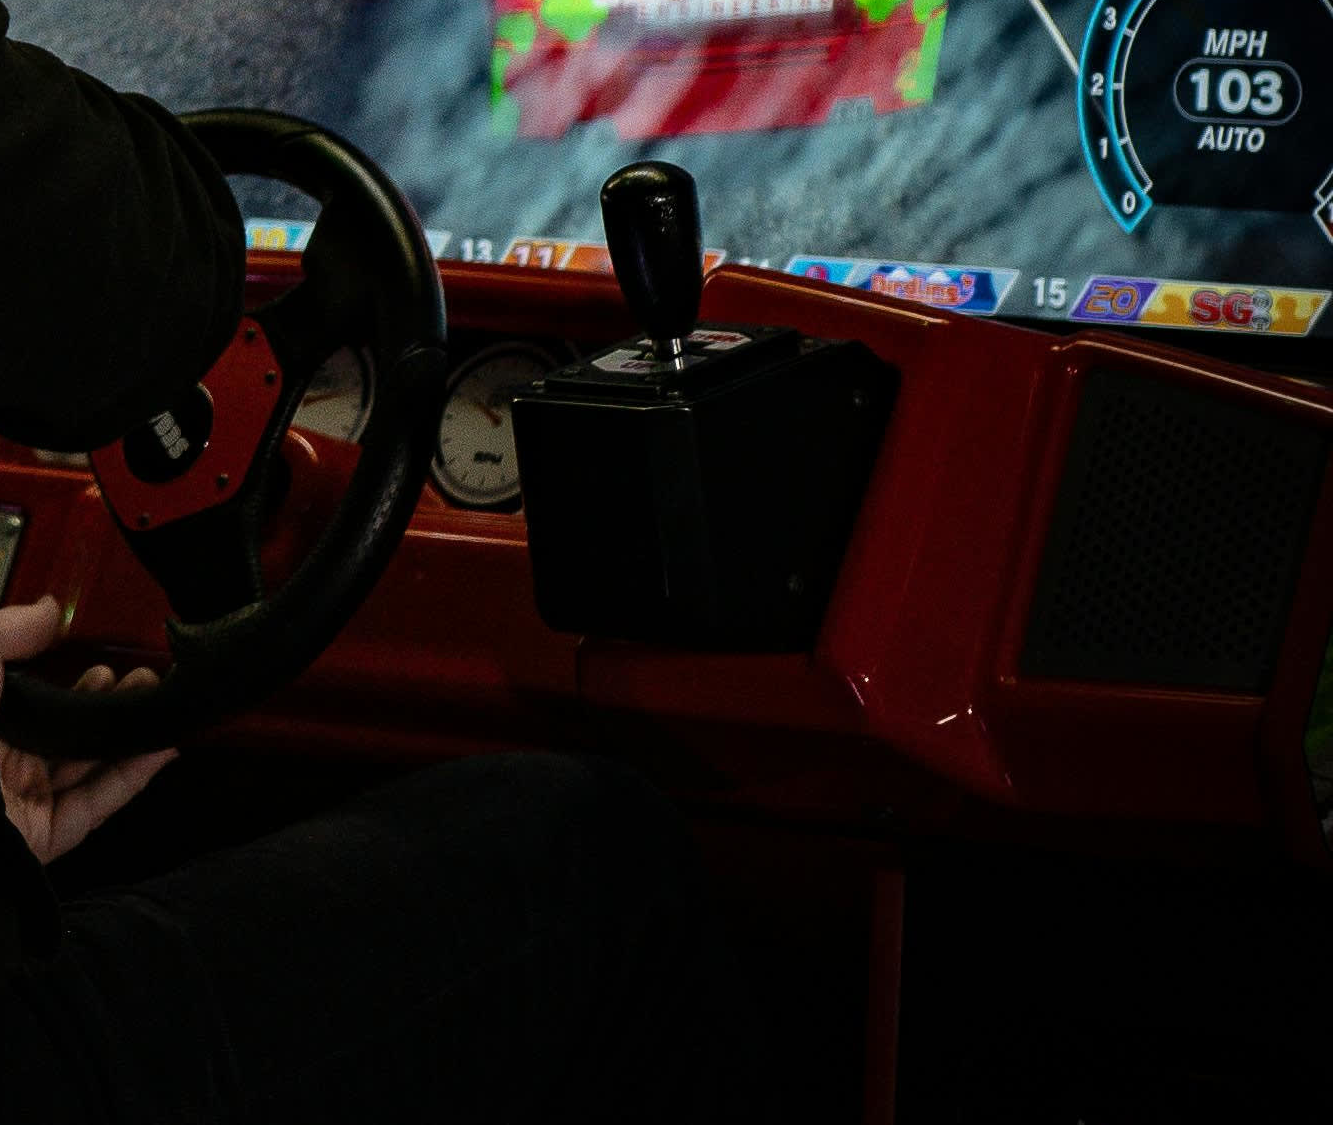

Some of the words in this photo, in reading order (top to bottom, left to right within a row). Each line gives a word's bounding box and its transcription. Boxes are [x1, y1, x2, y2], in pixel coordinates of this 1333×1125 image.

[1103, 6, 1117, 30] 3
[1203, 28, 1268, 58] MPH
[1090, 73, 1105, 96] 2
[1189, 69, 1283, 116] 103
[1099, 136, 1109, 160] 1
[1197, 125, 1266, 153] AUTO
[1121, 191, 1136, 215] 0
[515, 244, 554, 267] 11
[1033, 277, 1068, 308] 15
[1084, 283, 1148, 316] 20
